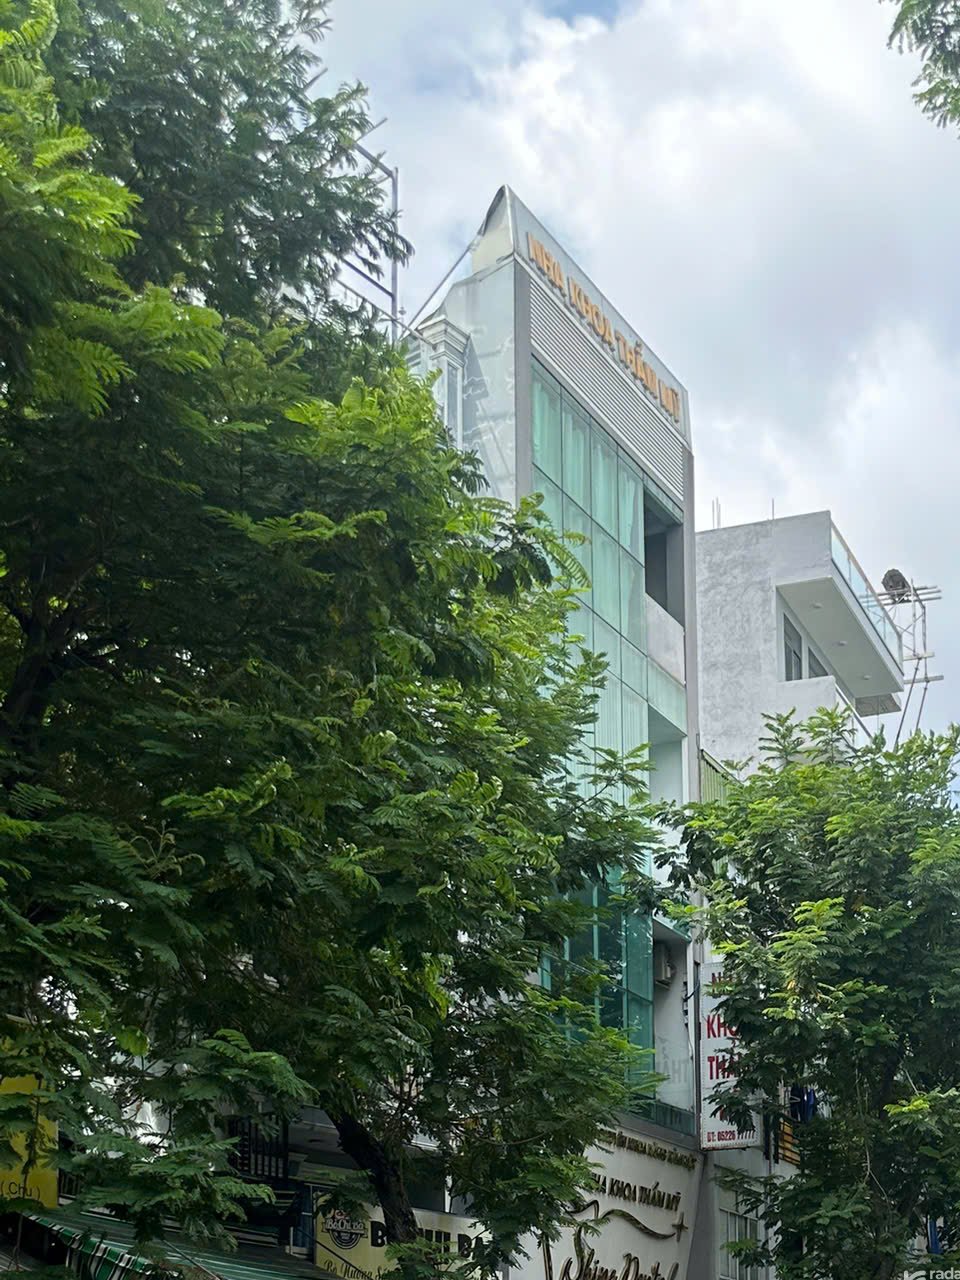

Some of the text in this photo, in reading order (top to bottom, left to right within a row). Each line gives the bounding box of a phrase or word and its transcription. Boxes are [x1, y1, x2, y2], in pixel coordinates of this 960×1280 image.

[527, 232, 567, 298] NHA
[567, 276, 615, 352] KHOA
[607, 1178, 637, 1202] KHOA
